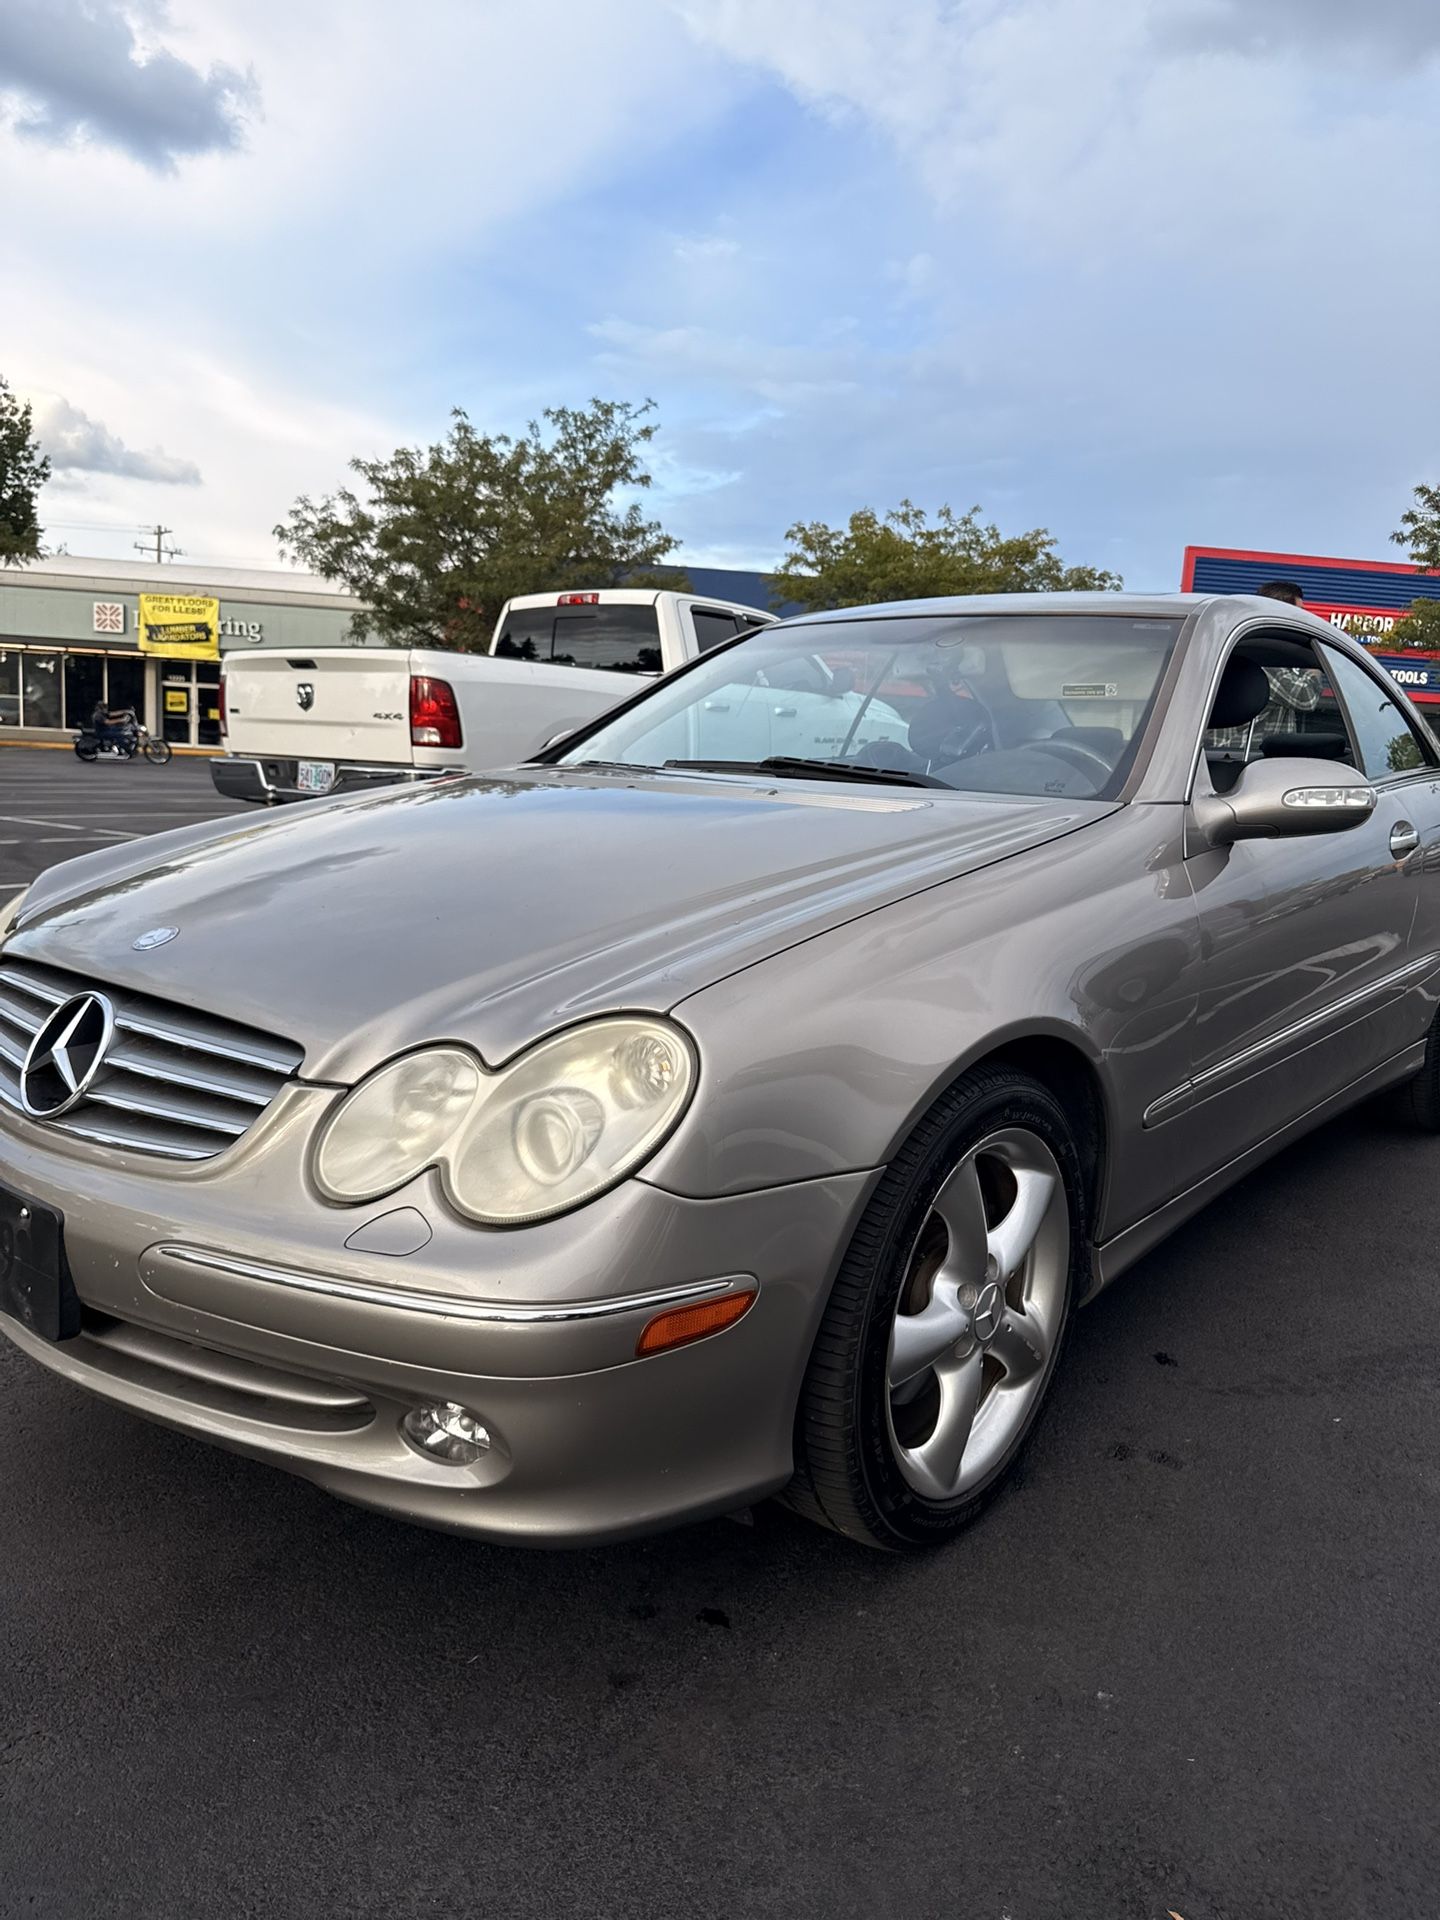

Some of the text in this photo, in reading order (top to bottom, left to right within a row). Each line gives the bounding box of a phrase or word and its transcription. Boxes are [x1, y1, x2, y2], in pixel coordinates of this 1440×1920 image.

[145, 595, 214, 608] GREAT FLOORS
[152, 605, 171, 613] FOR
[218, 616, 261, 642] ring
[1330, 612, 1394, 633] HARBOR
[161, 625, 196, 634] LUMBER
[153, 632, 207, 641] LIQUIDATORS
[1390, 669, 1429, 685] TOOLS
